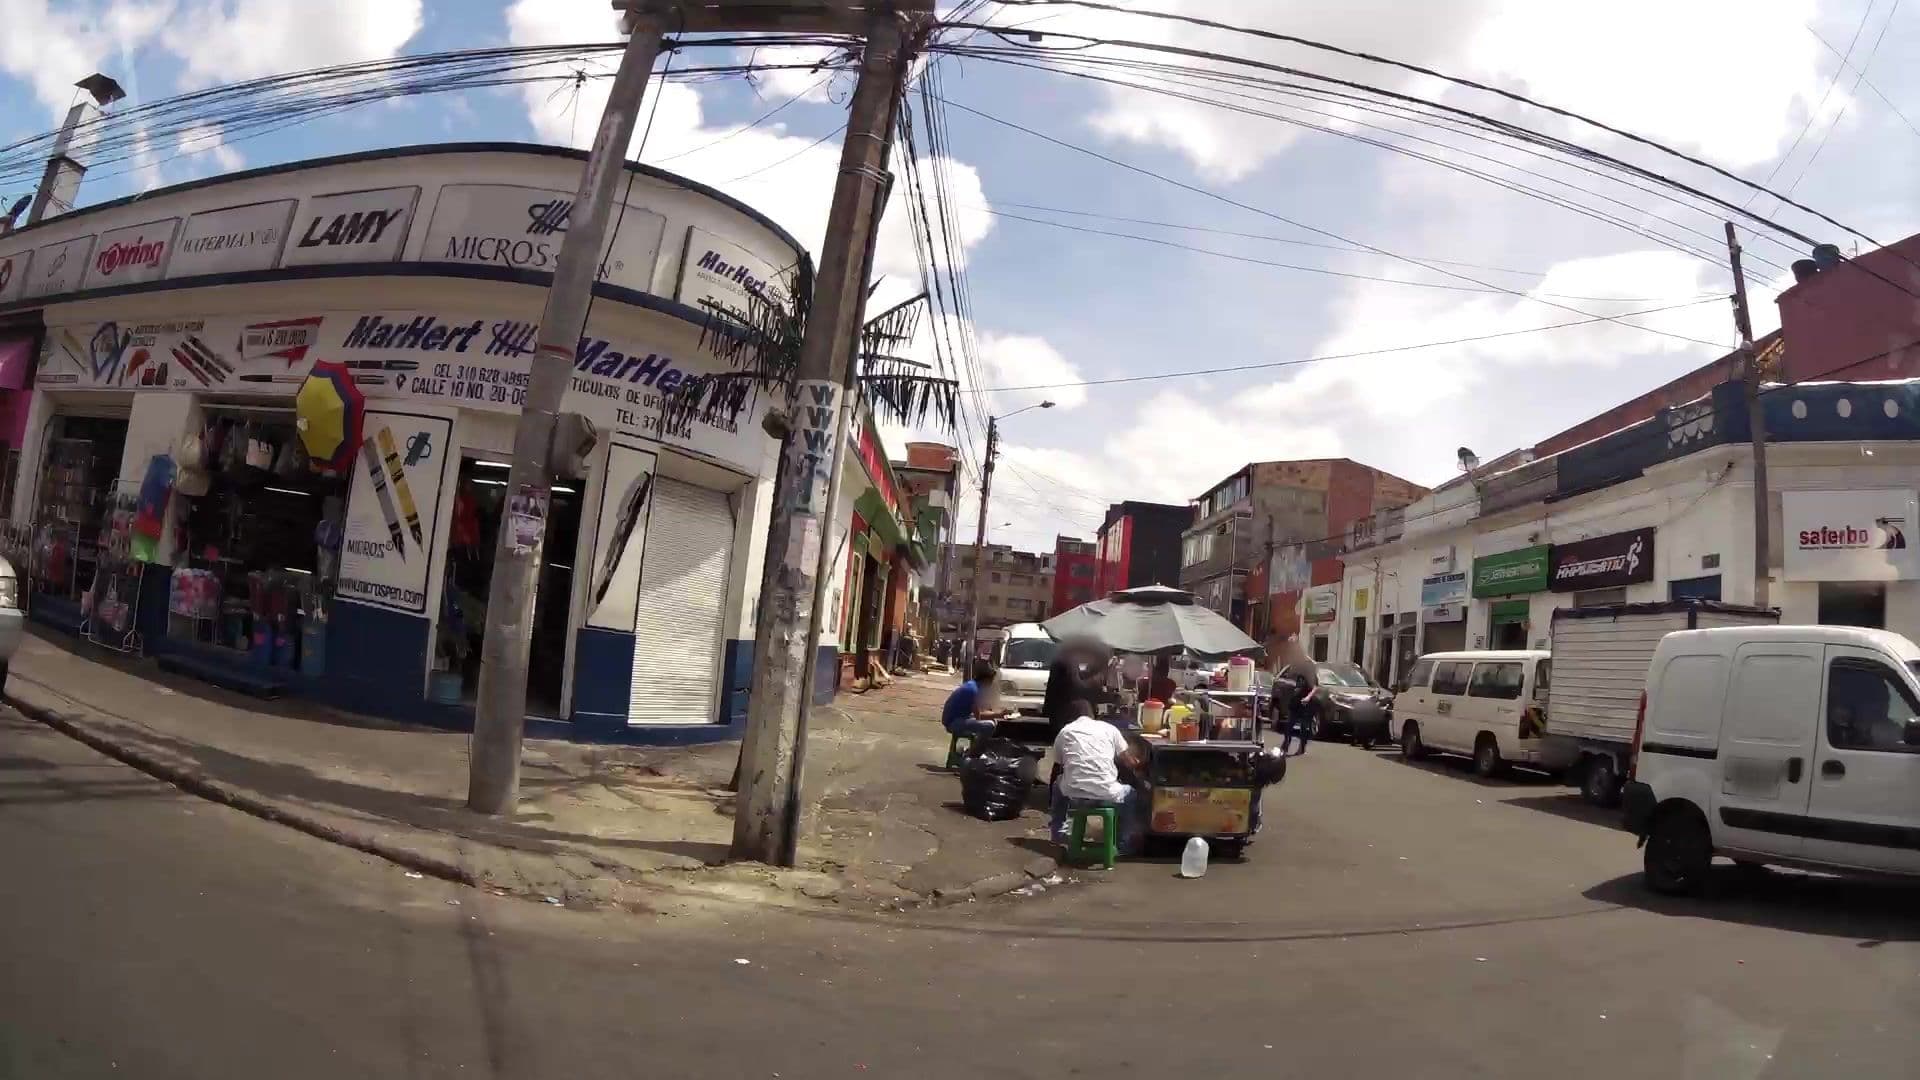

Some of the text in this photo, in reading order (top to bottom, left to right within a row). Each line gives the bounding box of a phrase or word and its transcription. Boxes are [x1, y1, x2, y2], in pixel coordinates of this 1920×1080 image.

[297, 208, 402, 247] LAMY
[342, 315, 482, 353] MarHert
[411, 377, 446, 396] CALLE
[1799, 525, 1869, 546] saferbo
